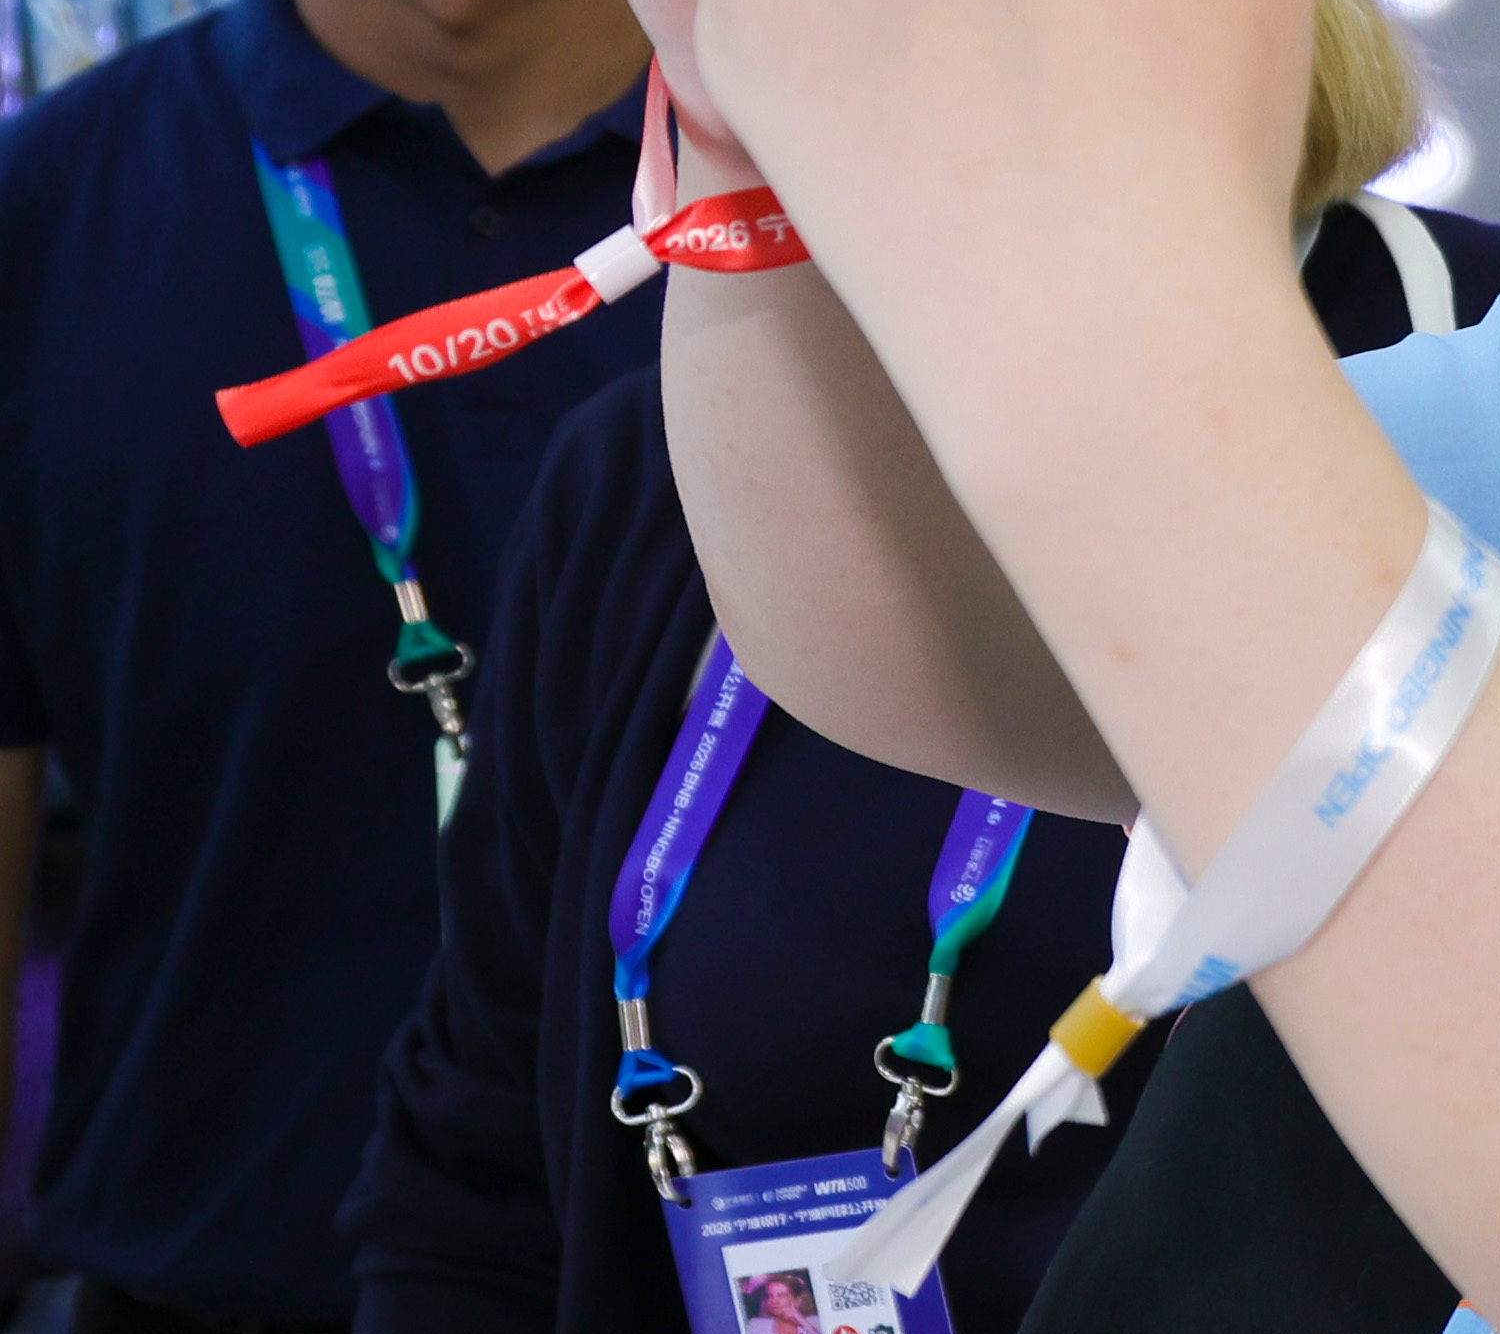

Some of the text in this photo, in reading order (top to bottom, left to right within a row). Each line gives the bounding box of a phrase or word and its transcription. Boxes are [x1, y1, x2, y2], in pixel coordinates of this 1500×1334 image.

[665, 219, 750, 254] 2026
[387, 317, 519, 383] 10/20
[642, 813, 681, 883] NINGBO
[634, 882, 655, 937] OPEN
